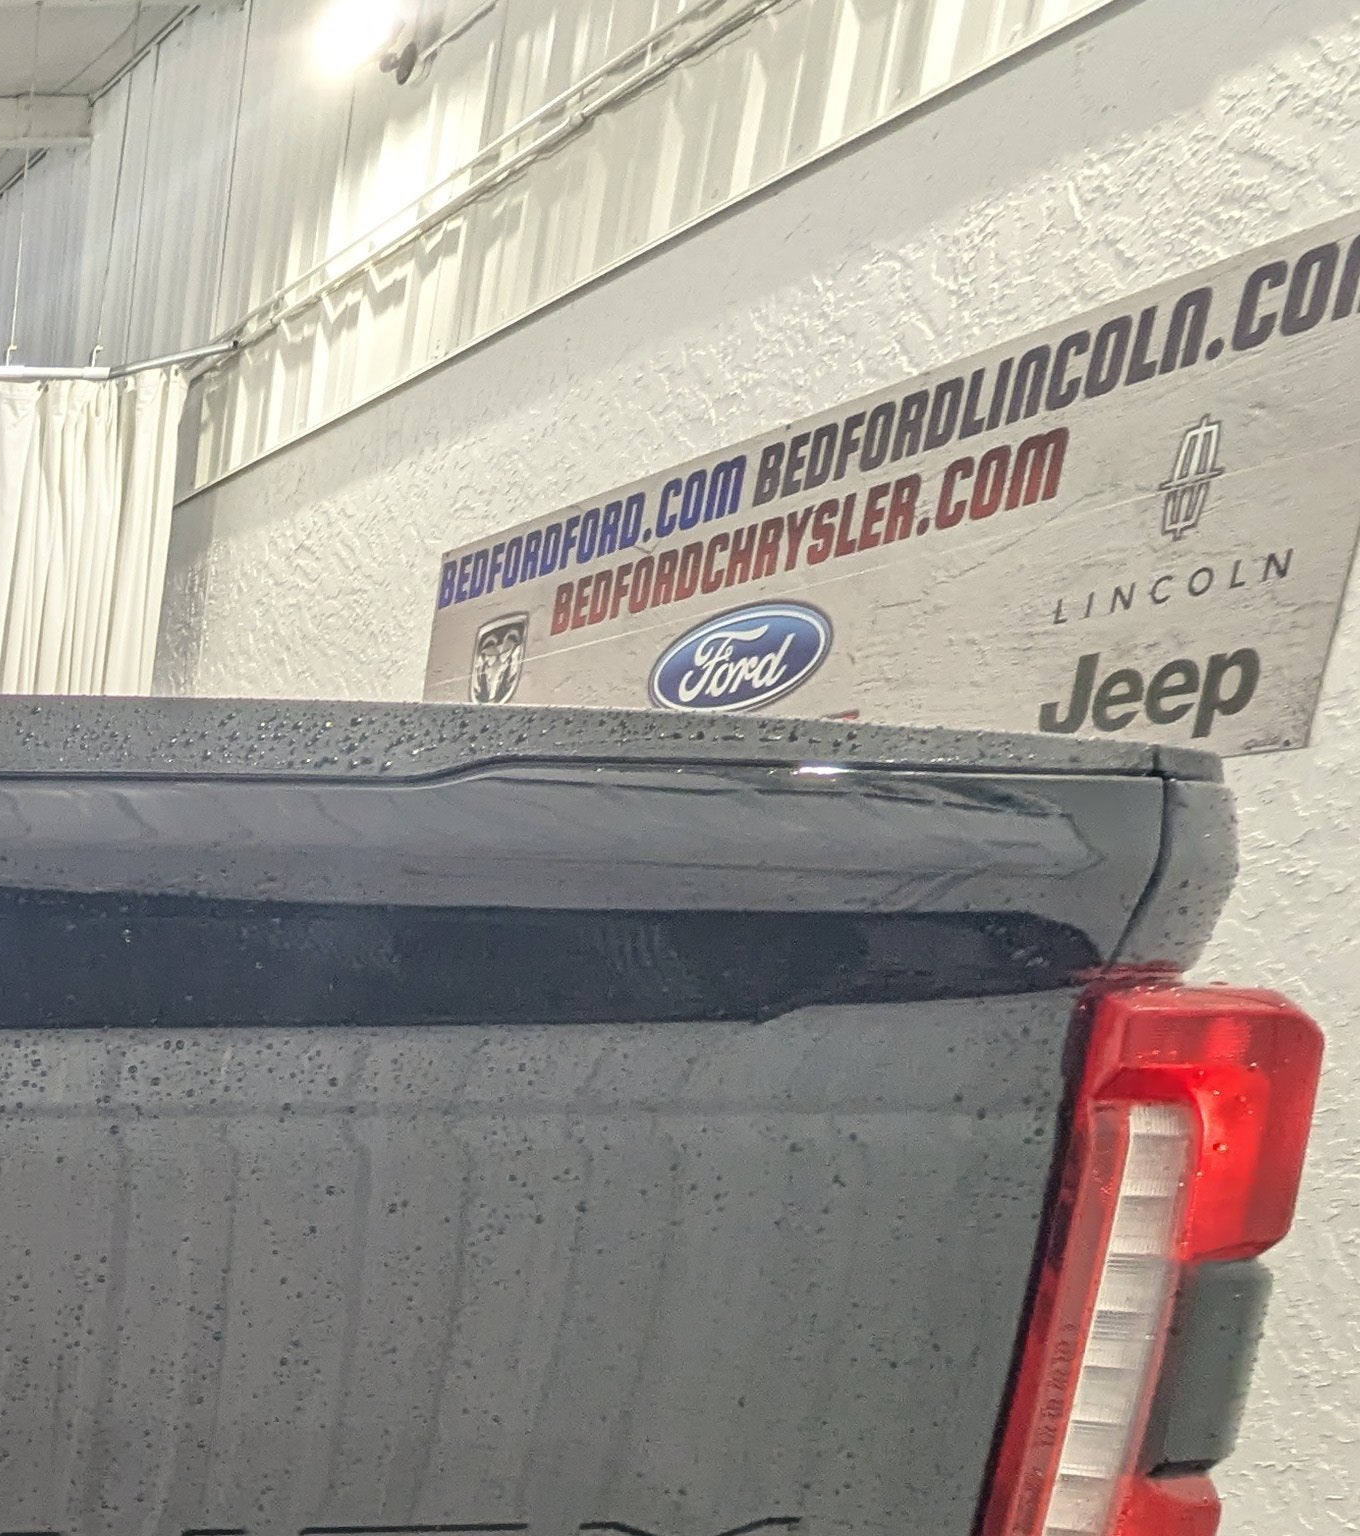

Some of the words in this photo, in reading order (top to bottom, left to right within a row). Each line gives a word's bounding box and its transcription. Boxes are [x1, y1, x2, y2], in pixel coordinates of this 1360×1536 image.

[437, 453, 747, 612] BEDFORDFORD.COM
[549, 426, 1071, 637] BEDFORDCHRYSLER.COM
[1052, 548, 1294, 625] LINCOLN
[678, 623, 796, 703] Ford
[1038, 647, 1261, 740] Jeep
